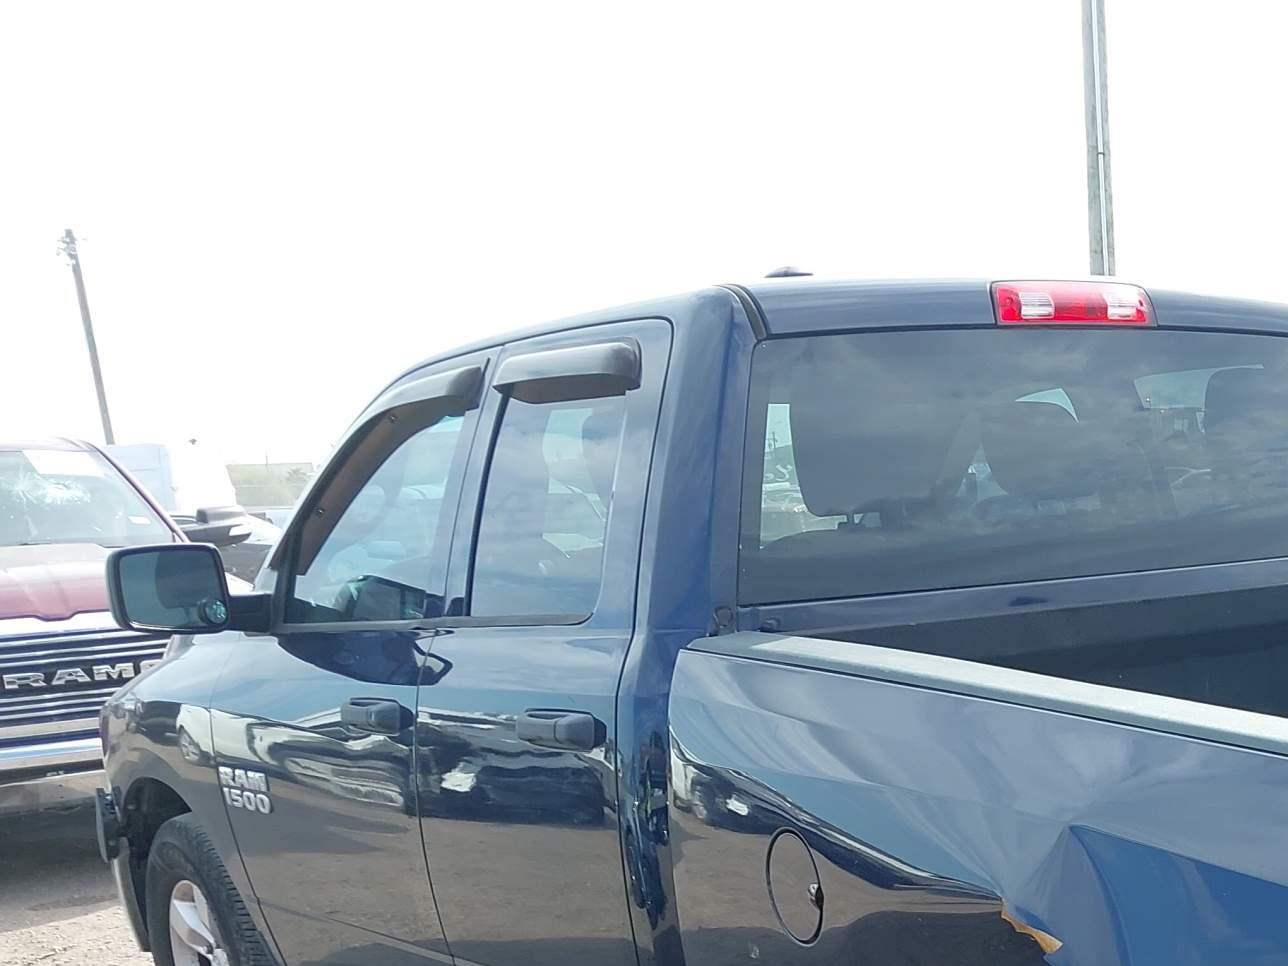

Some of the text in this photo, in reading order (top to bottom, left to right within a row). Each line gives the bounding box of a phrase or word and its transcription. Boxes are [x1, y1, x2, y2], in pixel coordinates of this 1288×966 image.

[3, 663, 135, 689] RAM
[219, 766, 267, 792] RAM
[223, 787, 271, 814] 1500
